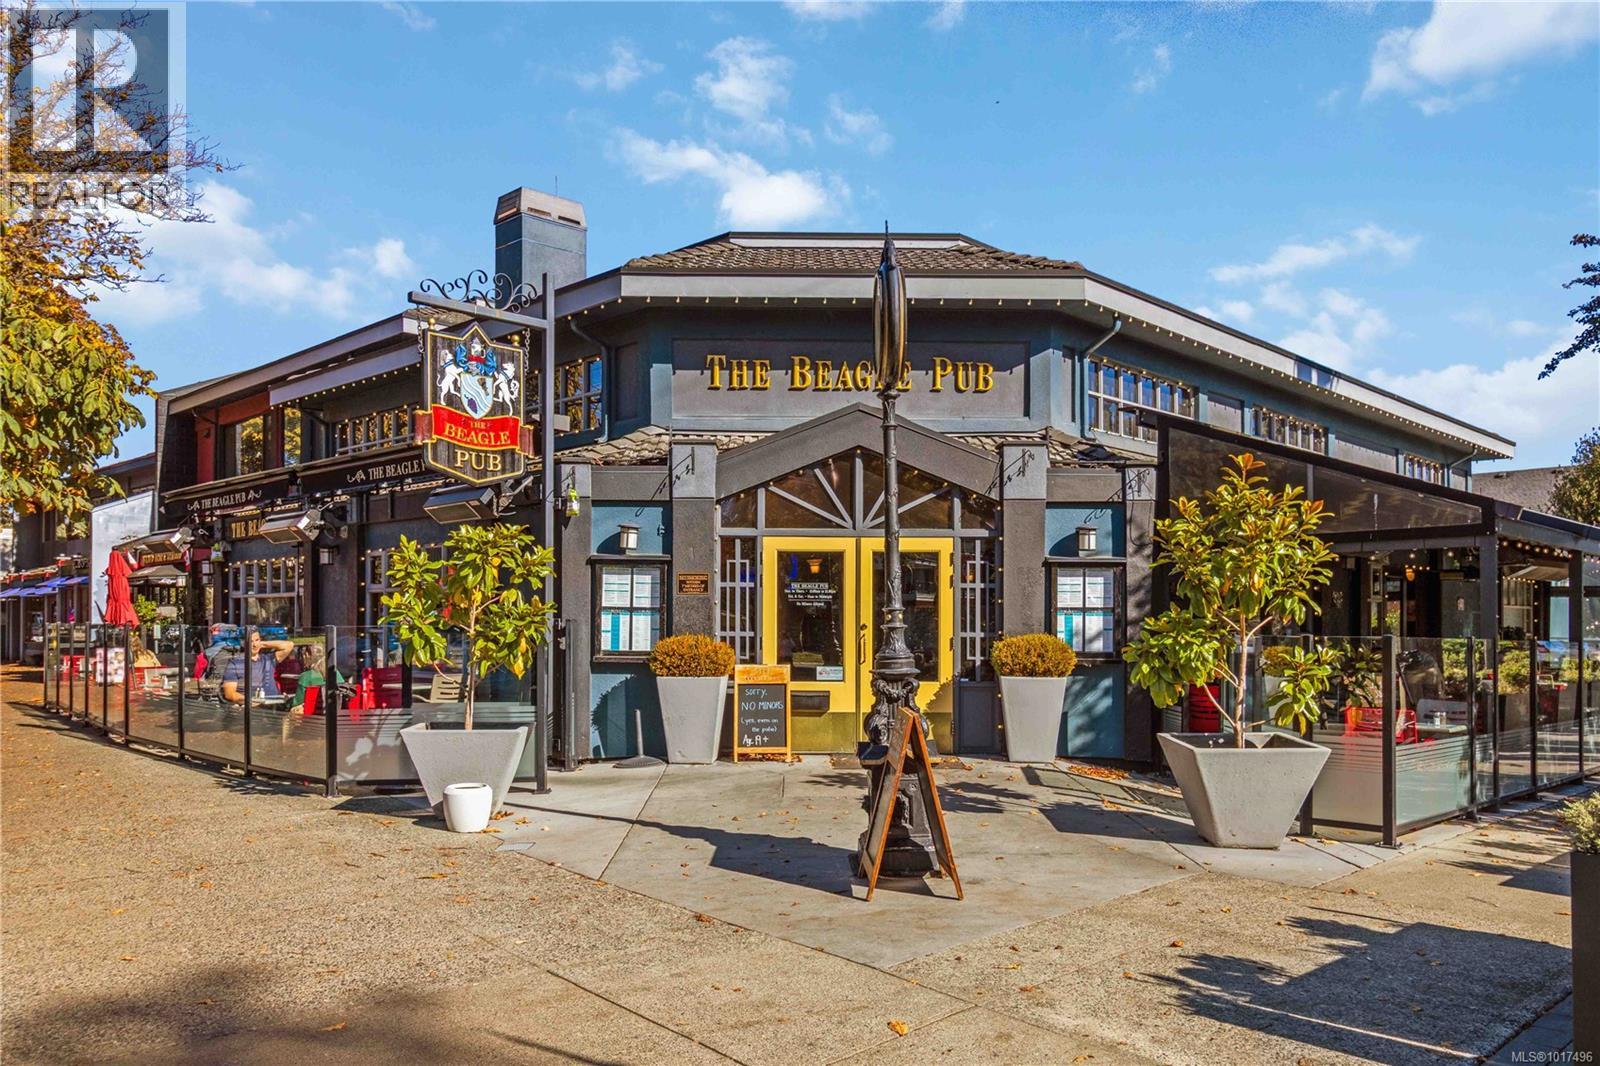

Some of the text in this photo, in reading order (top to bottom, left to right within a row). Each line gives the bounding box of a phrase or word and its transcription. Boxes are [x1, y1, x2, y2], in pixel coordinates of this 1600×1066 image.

[706, 354, 995, 393] THE BEAGE PUB
[444, 423, 511, 445] BEAGLE
[470, 421, 487, 430] THE
[368, 466, 385, 480] THE
[385, 459, 420, 477] BEAGLE
[454, 449, 502, 471] PUB
[201, 491, 247, 510] THE BEAGLE PUB
[231, 521, 246, 539] THE
[741, 701, 784, 711] NO MINORS
